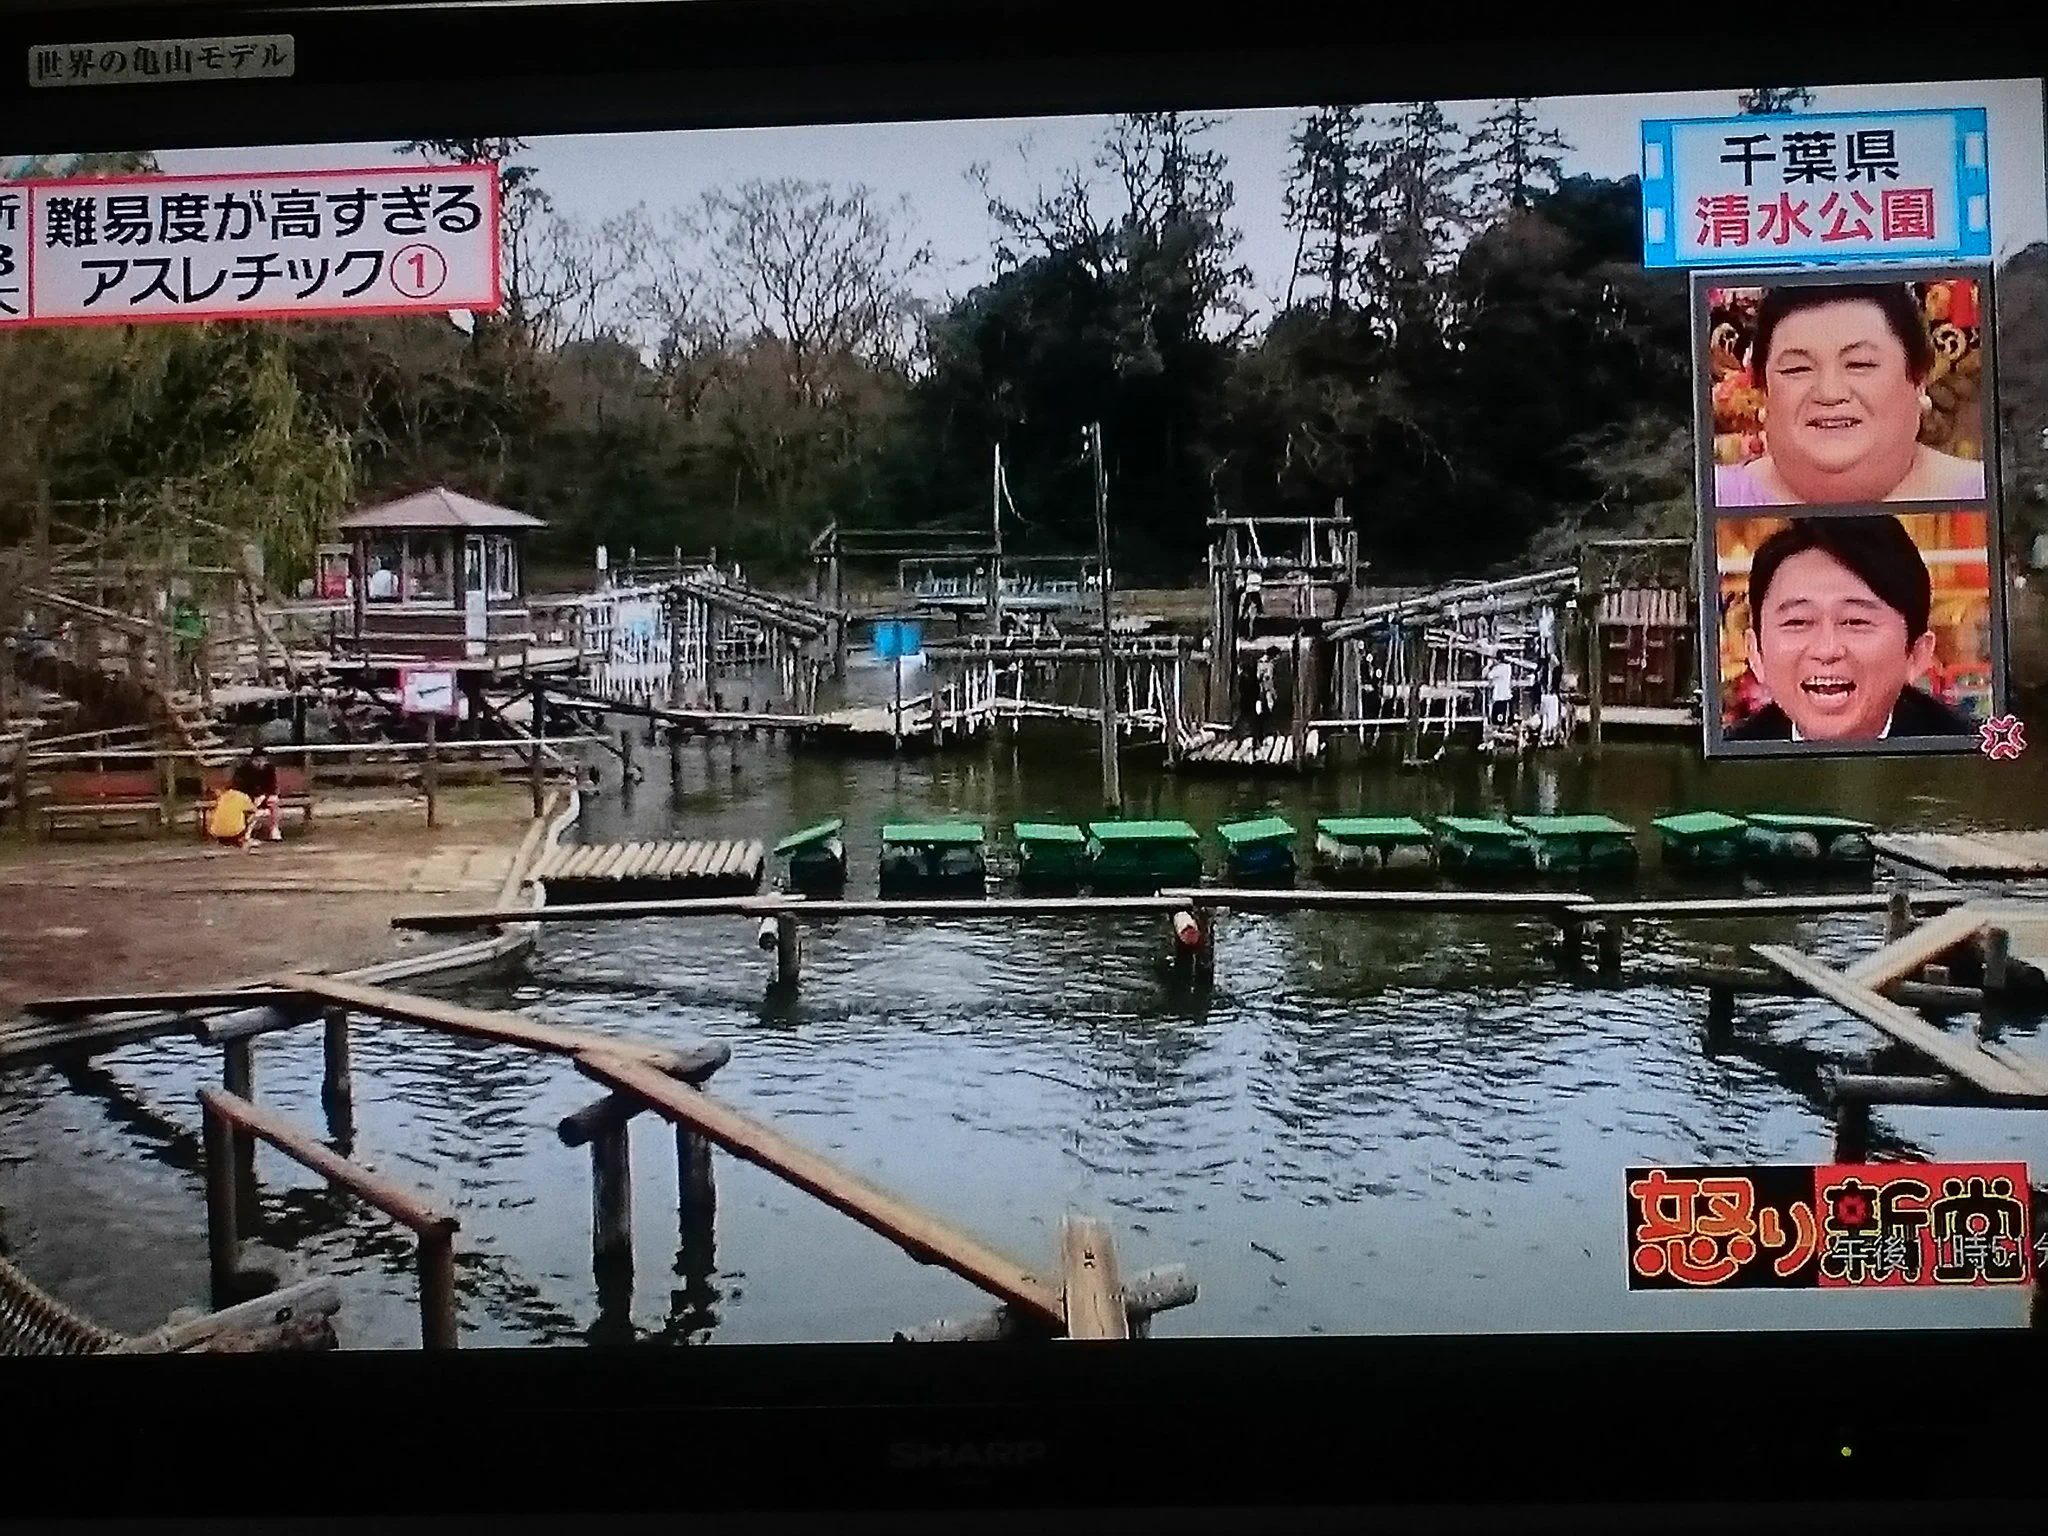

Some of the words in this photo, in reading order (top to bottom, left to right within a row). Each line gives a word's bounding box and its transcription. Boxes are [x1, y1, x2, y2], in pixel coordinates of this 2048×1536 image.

[36, 44, 288, 80] 世界の亀山モデル
[1719, 128, 1900, 187] 千葉県
[46, 184, 483, 248] 難易度が高すぎる
[1694, 187, 1936, 248] 清水公園
[889, 1440, 1047, 1468] SHARP
